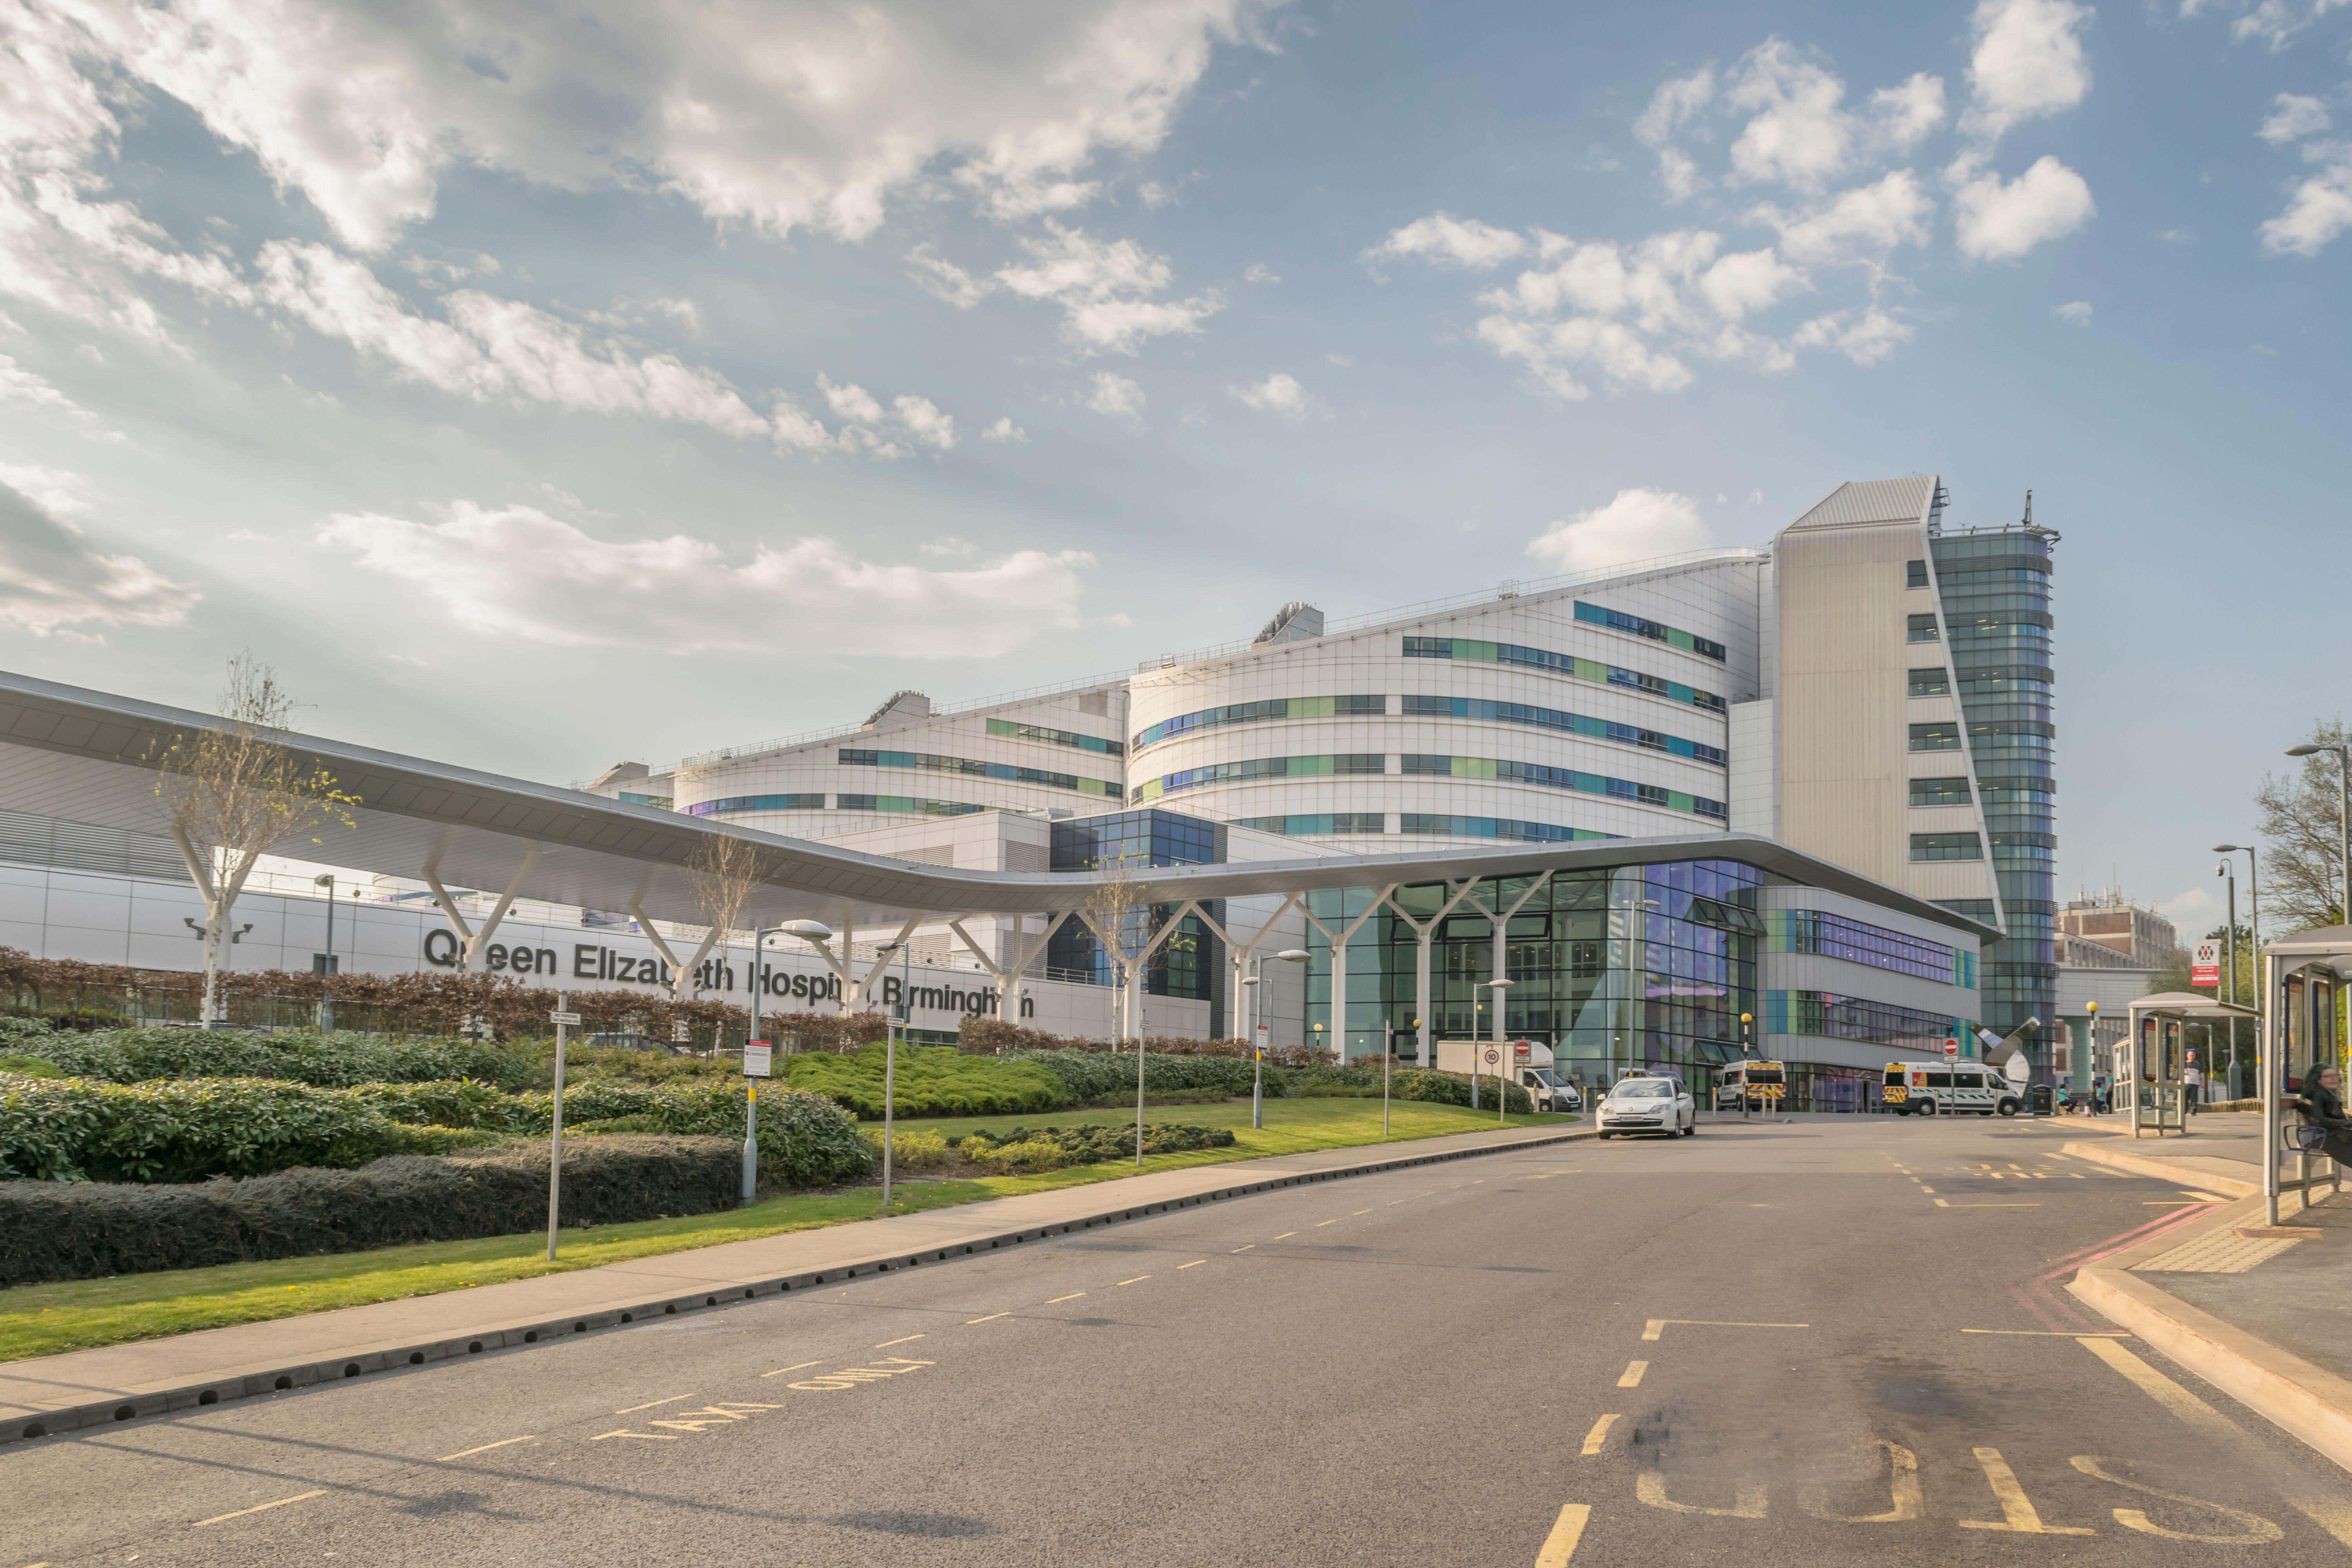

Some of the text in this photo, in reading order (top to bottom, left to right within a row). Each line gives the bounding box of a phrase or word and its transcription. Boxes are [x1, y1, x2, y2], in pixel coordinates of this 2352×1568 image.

[425, 929, 556, 975] Qeen
[748, 962, 870, 1006] Hospi
[883, 976, 1034, 1018] Brminghm
[590, 1357, 937, 1440] TAXI ONLY
